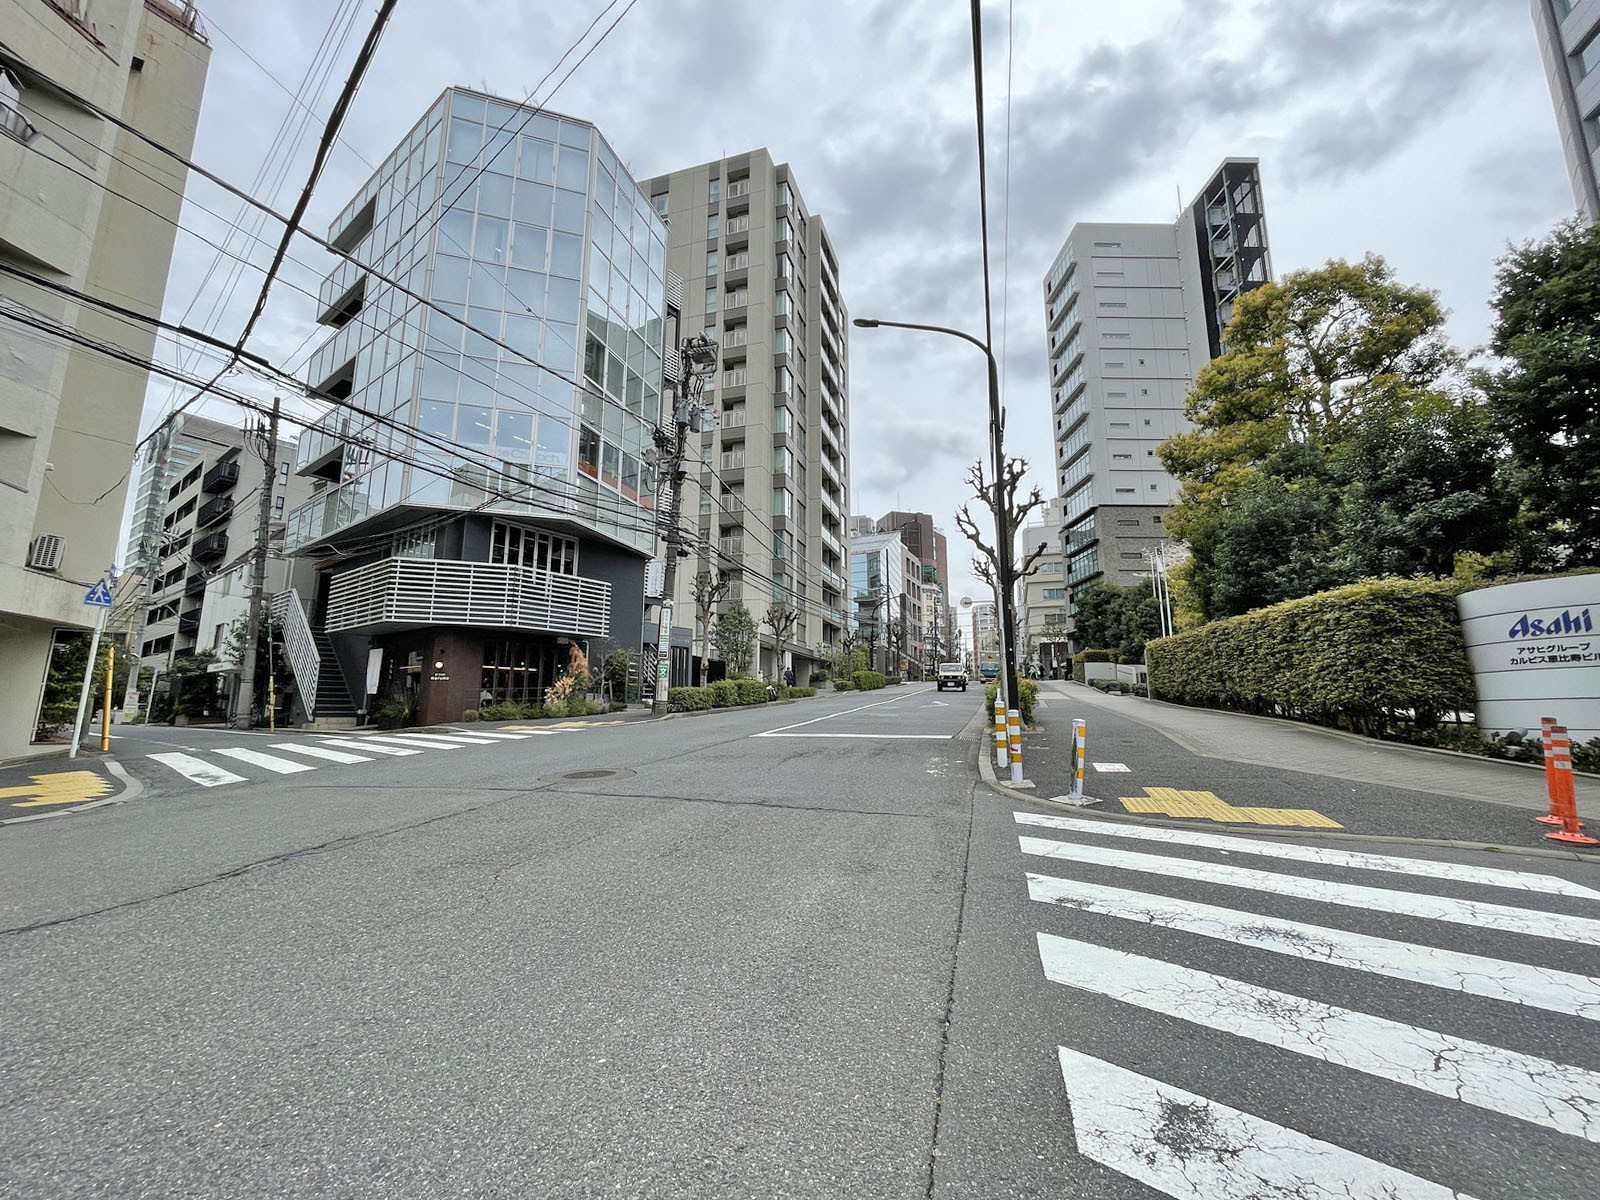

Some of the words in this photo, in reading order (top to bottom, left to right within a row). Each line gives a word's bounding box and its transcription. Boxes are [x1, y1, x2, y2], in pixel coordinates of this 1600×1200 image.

[1508, 608, 1592, 639] Asahi
[1517, 642, 1590, 655] アサヒグループ
